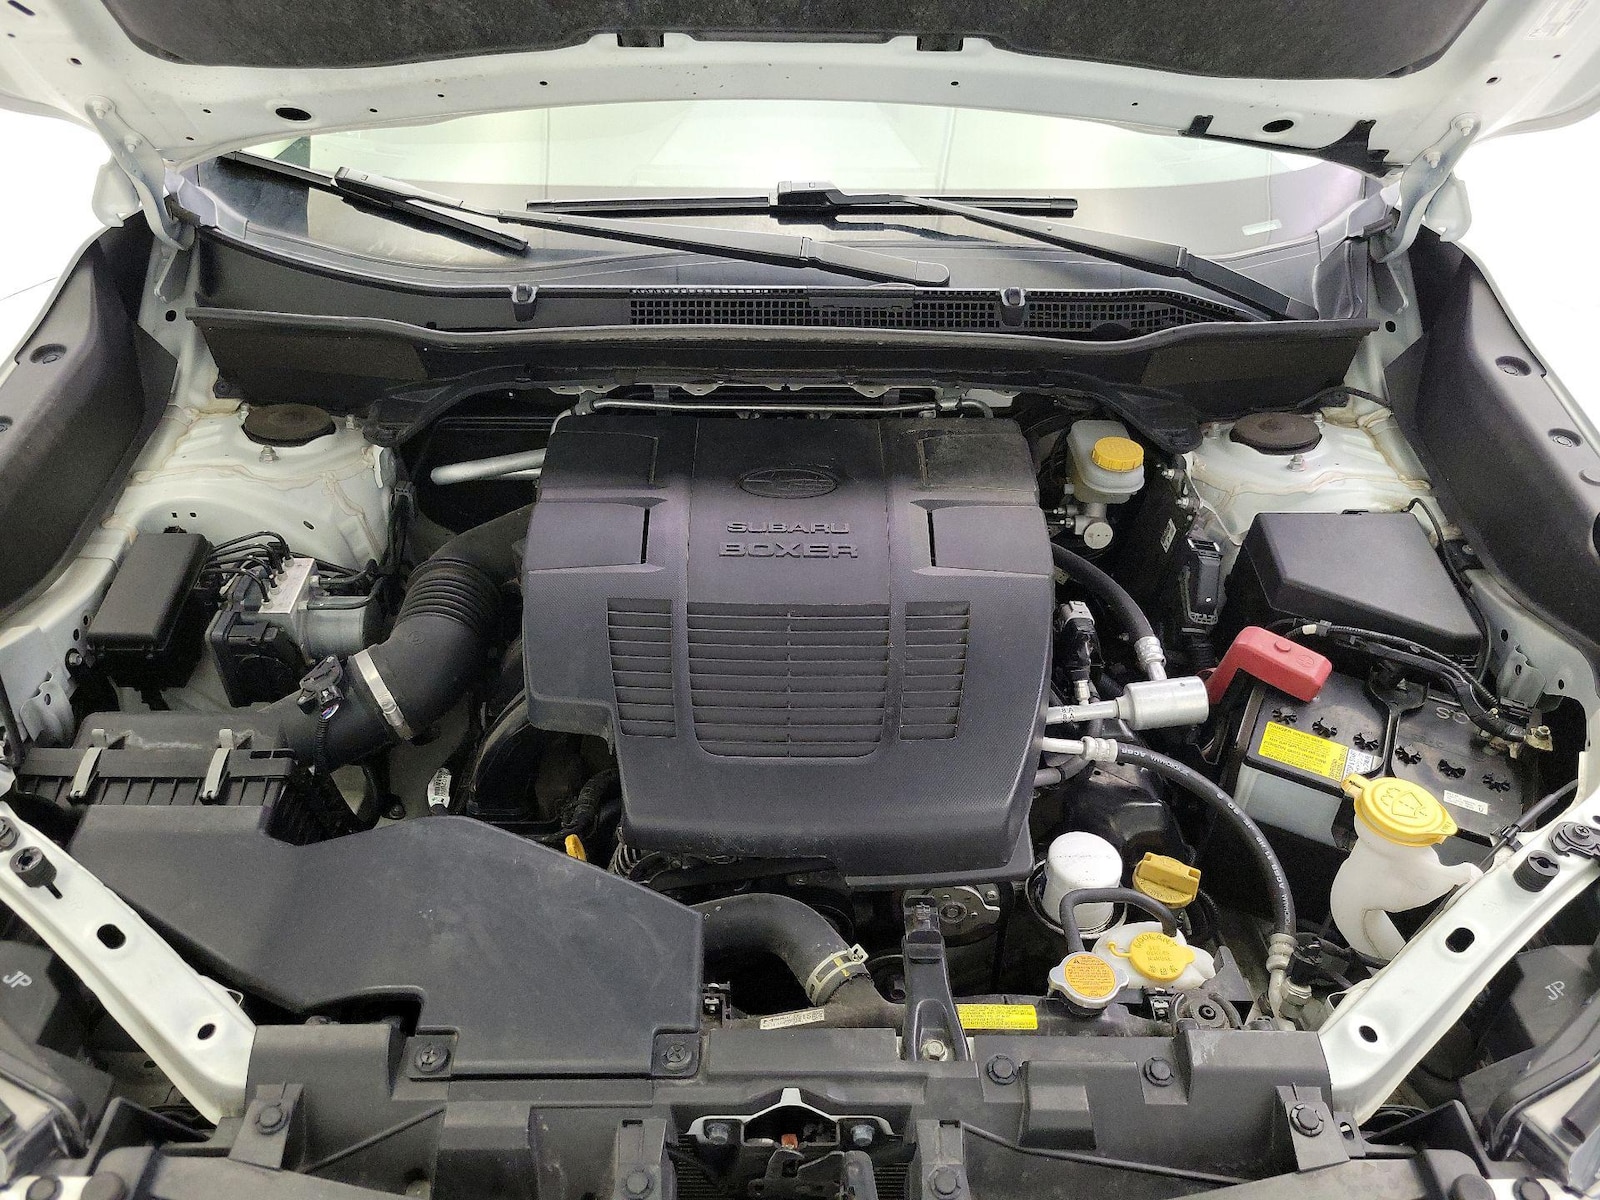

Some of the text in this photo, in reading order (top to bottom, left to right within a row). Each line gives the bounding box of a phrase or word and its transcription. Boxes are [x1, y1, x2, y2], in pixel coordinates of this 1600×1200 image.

[727, 521, 850, 534] SUBARU
[718, 542, 859, 559] BOXER
[2, 970, 33, 989] JP
[1544, 980, 1566, 1001] JP
